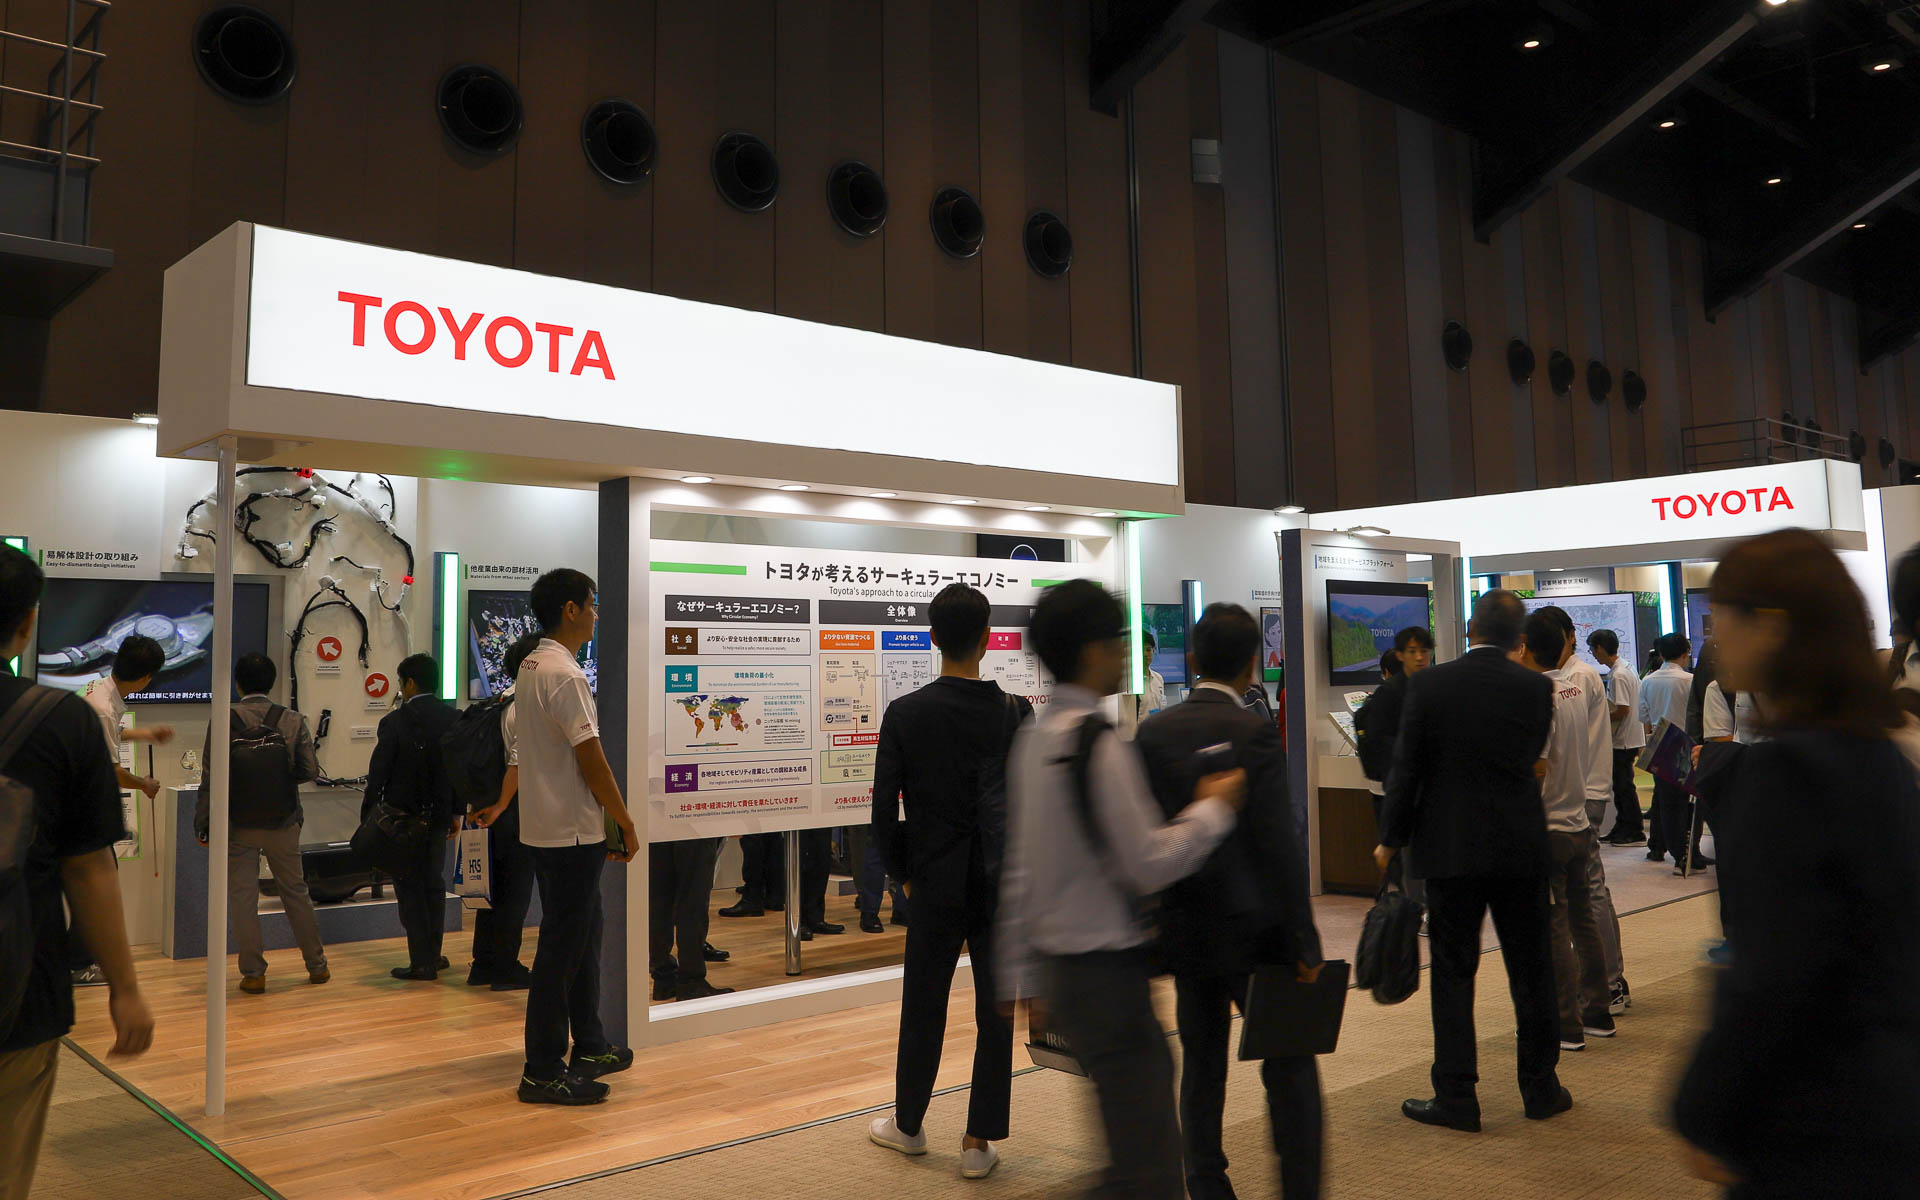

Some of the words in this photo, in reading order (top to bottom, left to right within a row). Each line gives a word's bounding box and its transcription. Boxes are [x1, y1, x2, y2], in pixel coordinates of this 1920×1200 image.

[338, 291, 615, 380] TOYOTA
[1652, 486, 1794, 521] TOYOTA
[47, 551, 138, 561] 易解体設計の取り組み
[470, 565, 539, 574] 他産業由来の部材活用
[766, 561, 1018, 588] トヨタが考えるサーキュラーエコノミー
[830, 586, 860, 596] Toyota's
[860, 588, 895, 597] approach
[896, 588, 903, 596] to
[887, 604, 916, 617] 全体像
[1370, 628, 1394, 637] TOYOTA
